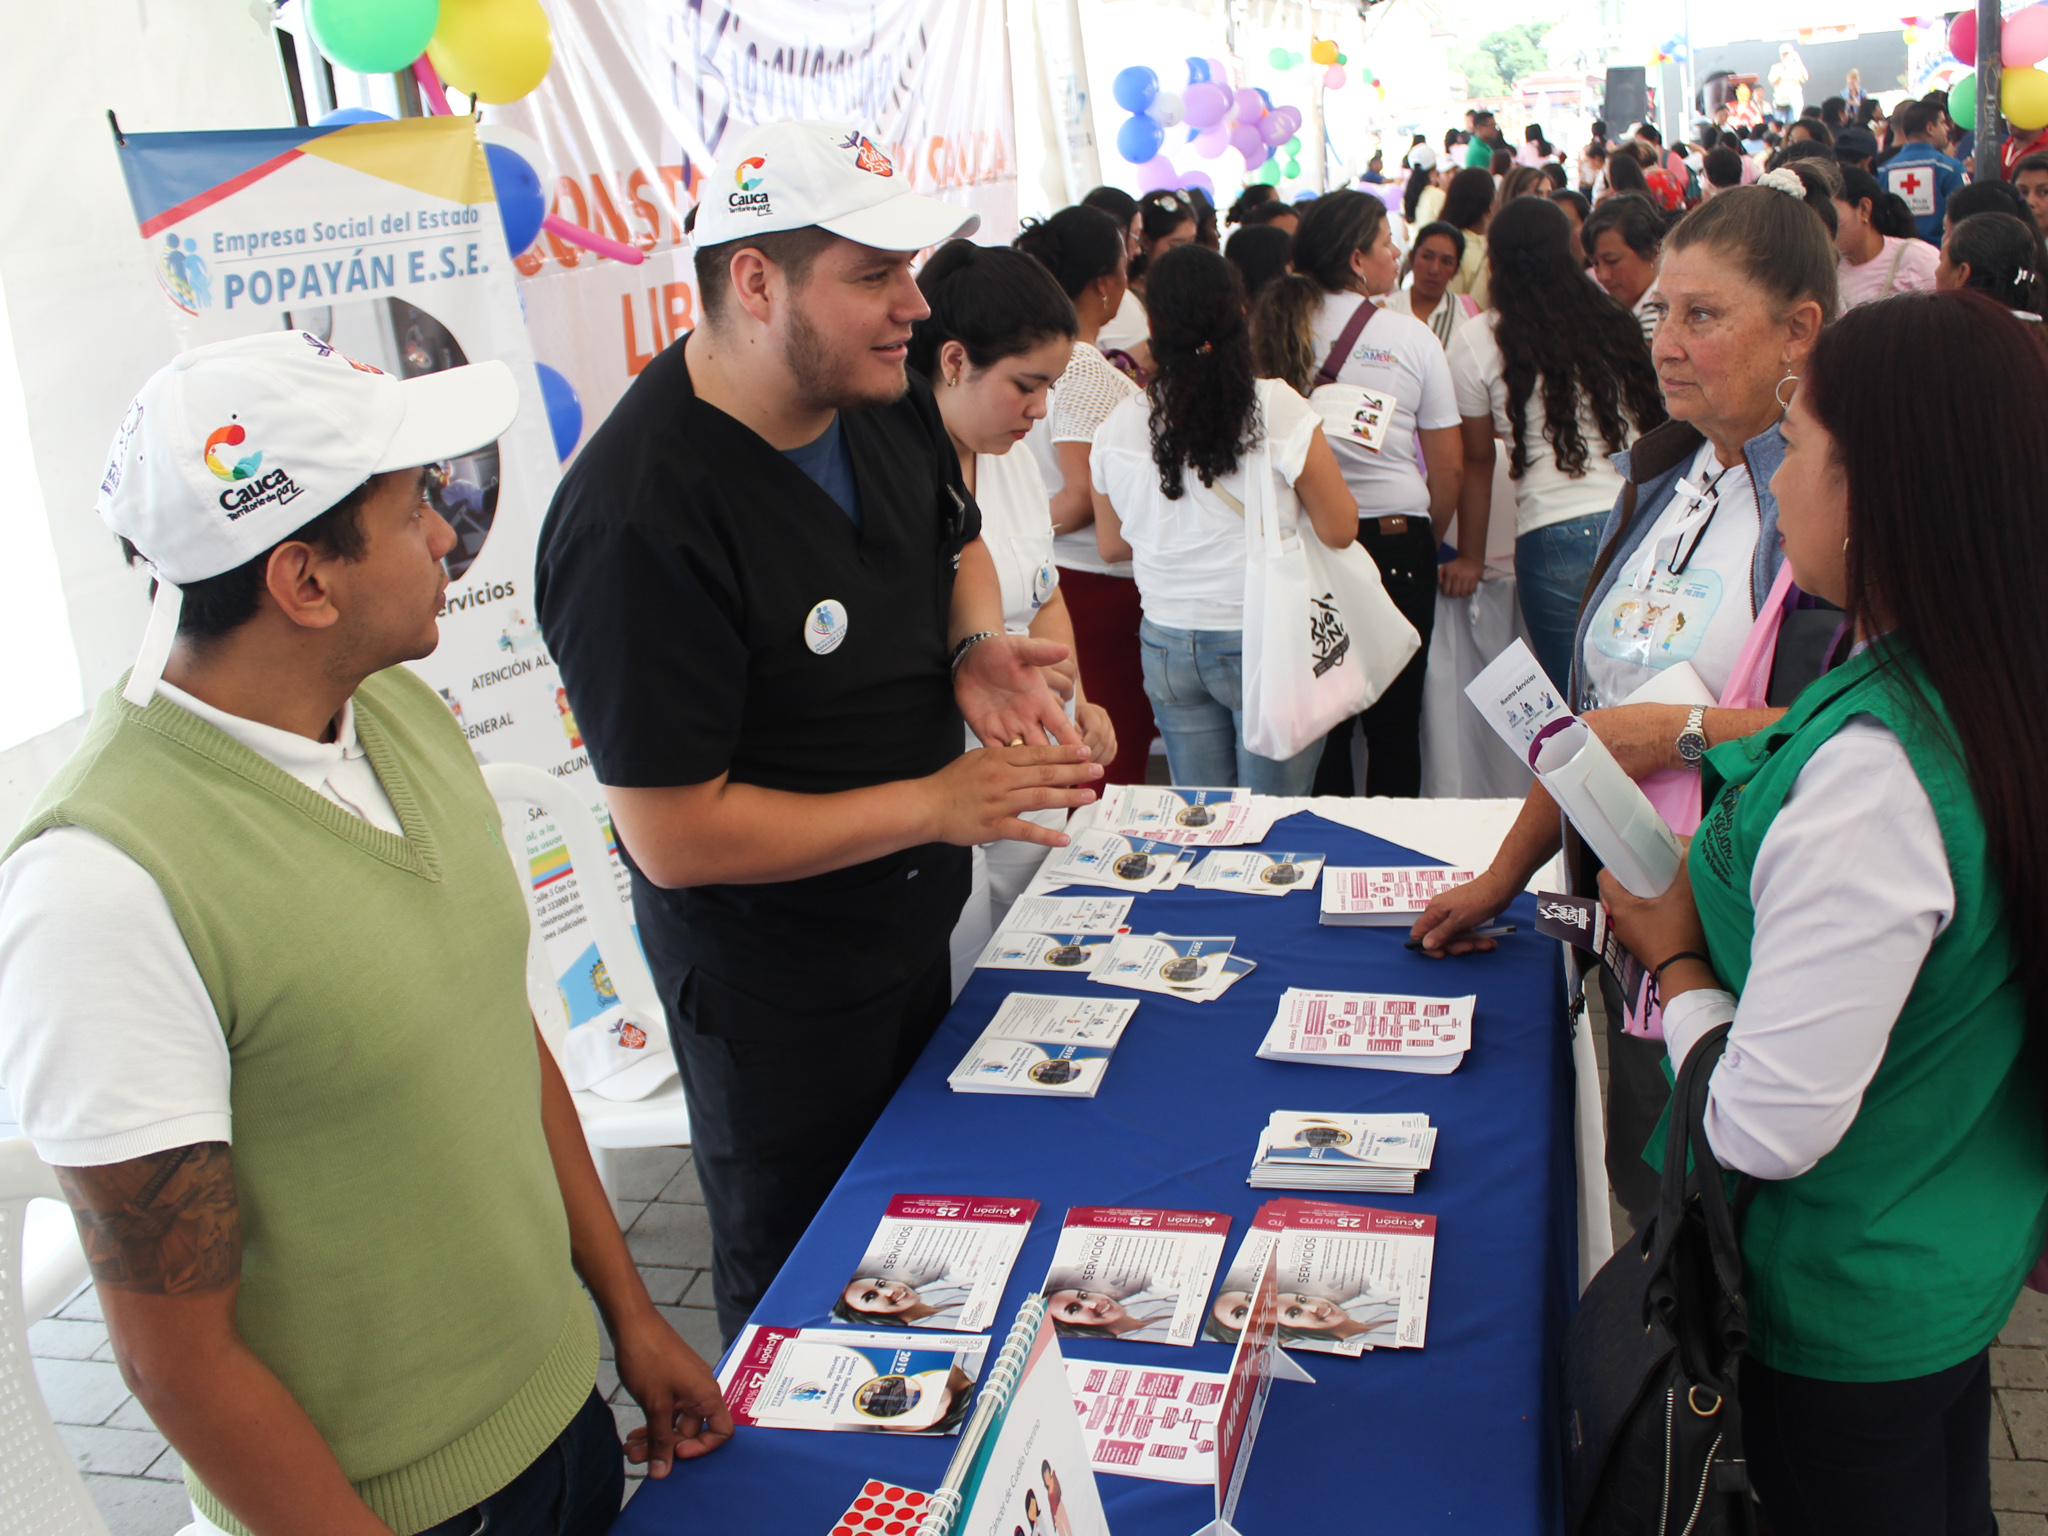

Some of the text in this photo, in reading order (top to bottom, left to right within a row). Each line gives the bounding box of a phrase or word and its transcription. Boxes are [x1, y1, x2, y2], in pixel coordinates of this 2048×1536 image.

[728, 192, 768, 206] Cauca
[757, 204, 773, 216] paz
[213, 205, 479, 256] Empresa Social del Estado
[512, 164, 708, 277] ONST
[224, 243, 489, 310] POPAYÁN E.S.E.
[219, 468, 289, 511] Cauca
[226, 496, 266, 521] Territorio
[276, 480, 304, 505] paz
[437, 581, 514, 618] ervicios
[471, 653, 550, 691] ATENCIÓN AL
[1500, 674, 1536, 706] Nuestros Servicios
[548, 756, 592, 778] VACUN
[528, 807, 548, 822] SA
[540, 834, 562, 850] usuar
[534, 892, 548, 904] alle
[1190, 942, 1202, 956] 2019
[1063, 1046, 1076, 1060] 2019
[1308, 1148, 1320, 1158] 2019
[883, 1226, 914, 1270] SERVICIOS
[1082, 1236, 1108, 1281] SERVICIOS
[1298, 1237, 1316, 1284] SERVICIOS
[895, 1352, 912, 1374] 2019
[1223, 1283, 1272, 1458] INNOVAGEN
[1005, 1488, 1012, 1504] de
[1010, 1456, 1026, 1488] Cuello
[1024, 1419, 1040, 1456] Uterino
